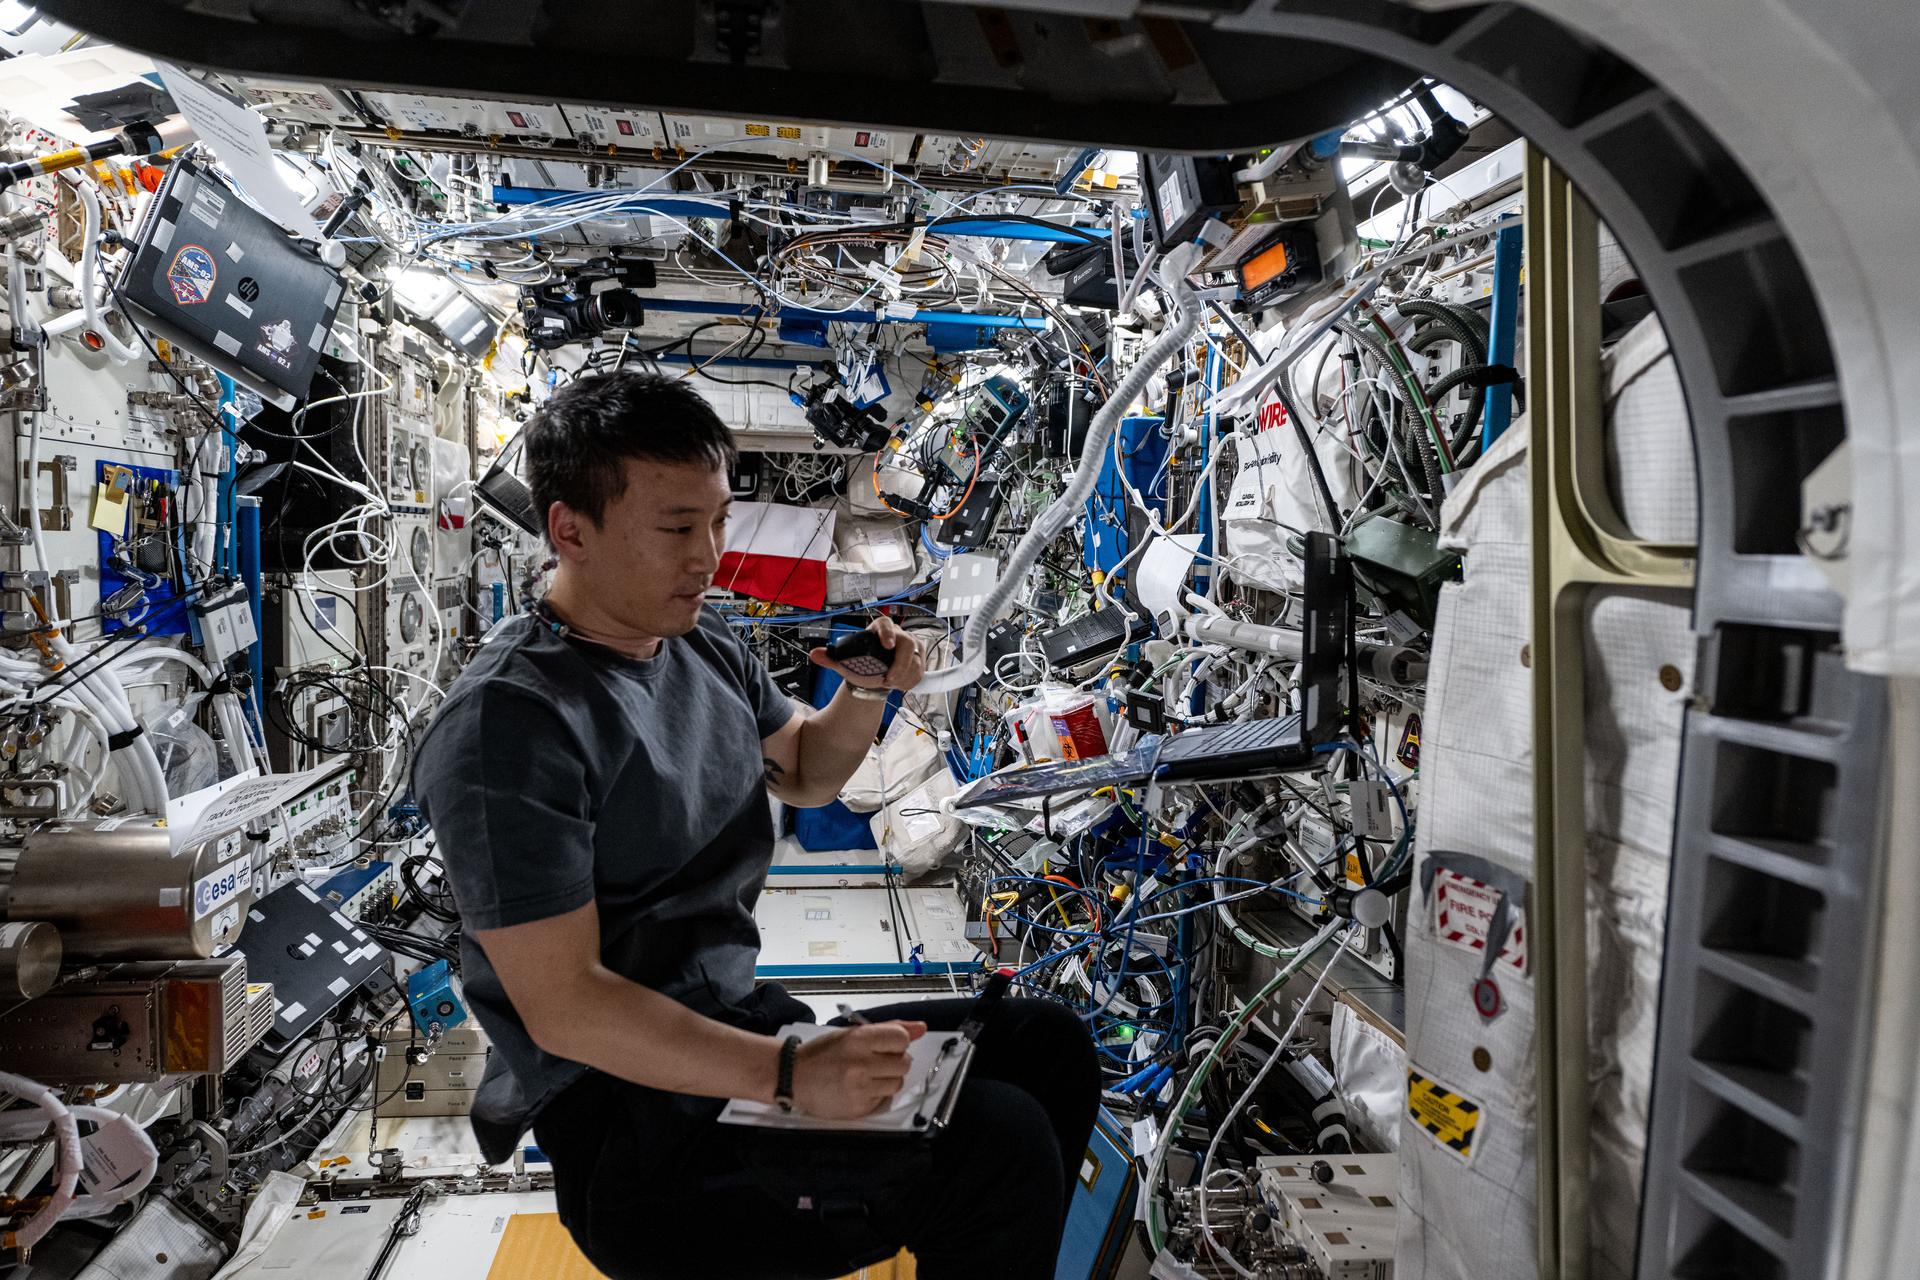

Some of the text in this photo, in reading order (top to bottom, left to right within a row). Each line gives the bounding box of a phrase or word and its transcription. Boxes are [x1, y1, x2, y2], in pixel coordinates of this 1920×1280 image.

[180, 255, 212, 281] AMS-02
[239, 277, 259, 303] hp
[256, 344, 291, 369] AMS 02.1
[207, 810, 224, 822] rack
[212, 874, 235, 900] esa
[1450, 899, 1477, 918] FIRE
[1423, 1092, 1450, 1115] CAUTION
